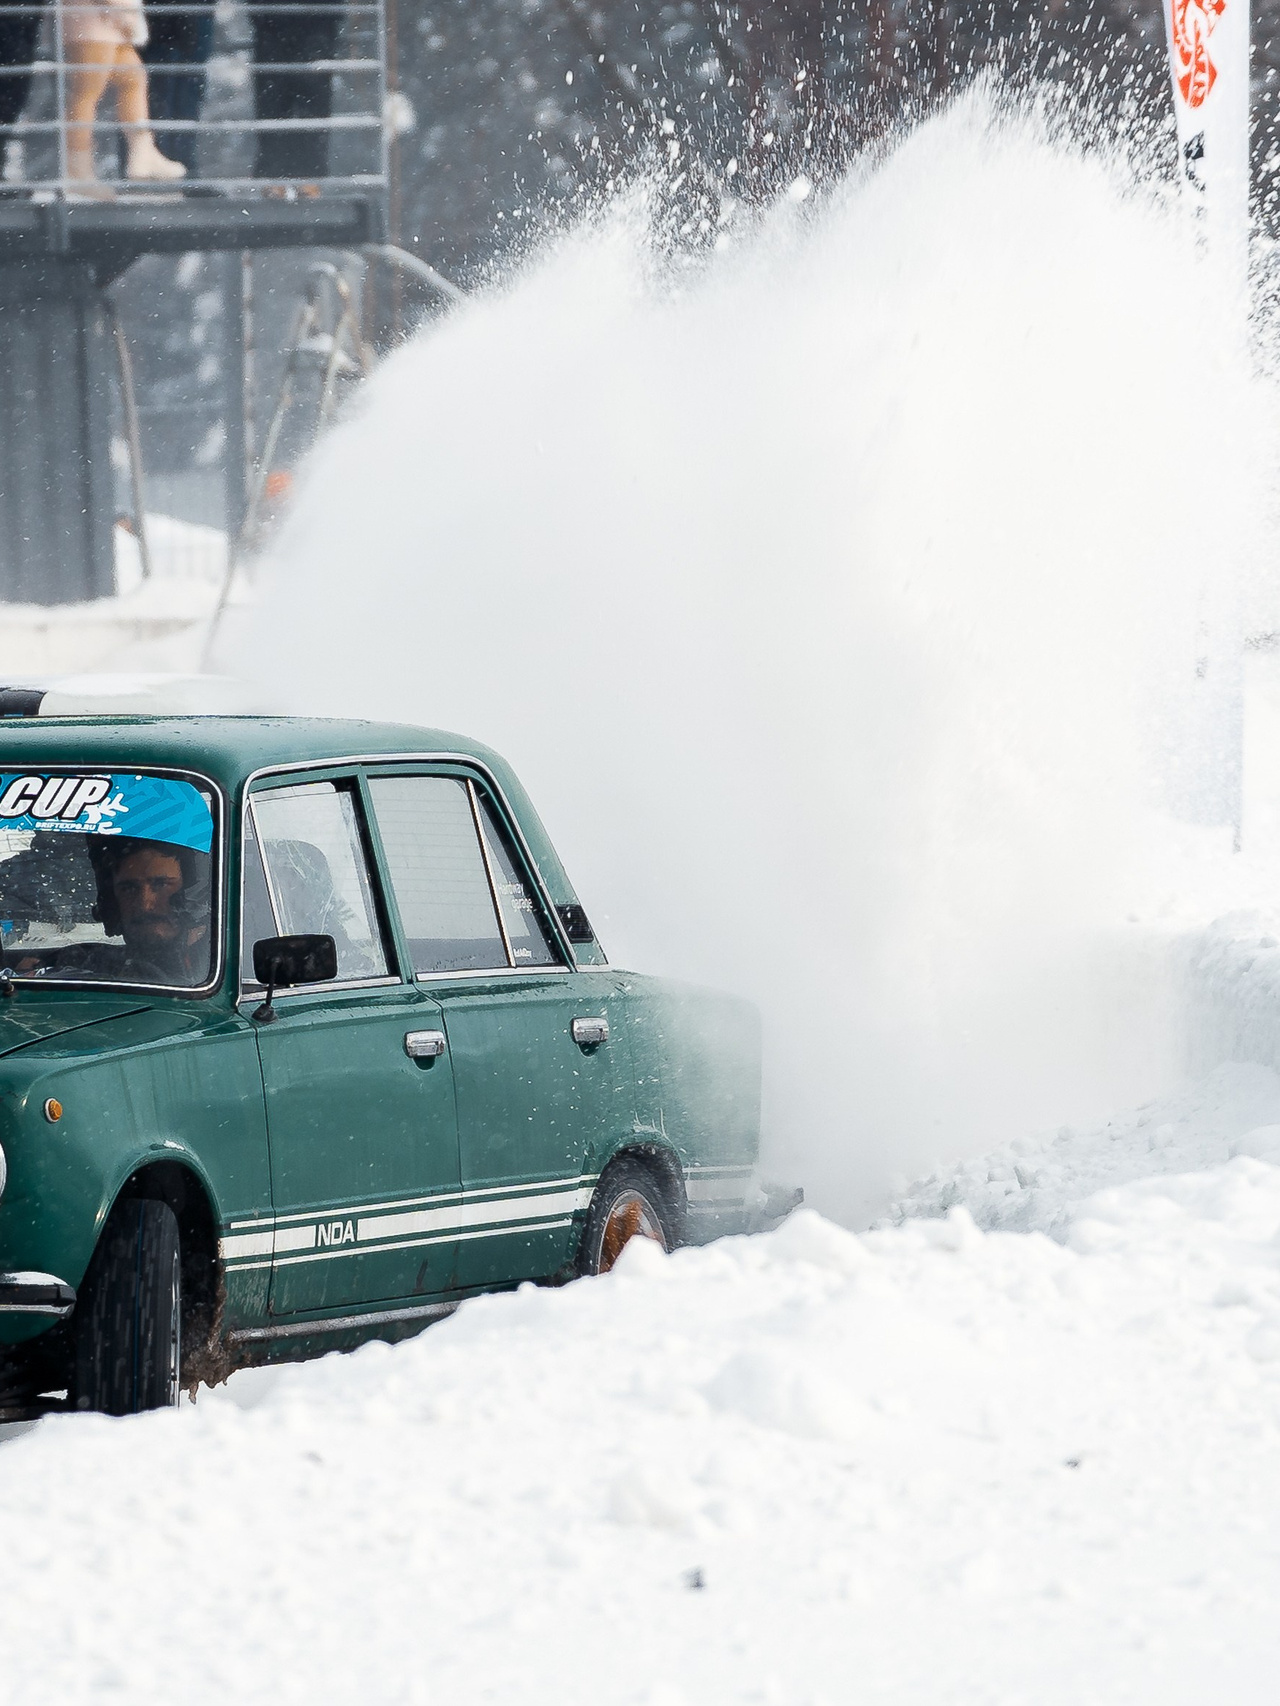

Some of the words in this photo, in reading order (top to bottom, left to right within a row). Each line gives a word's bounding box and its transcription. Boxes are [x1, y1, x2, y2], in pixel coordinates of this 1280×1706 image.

[6, 775, 112, 819] CUP
[35, 821, 96, 831] DRIFTEXPO.RU
[317, 1219, 356, 1247] NDA
